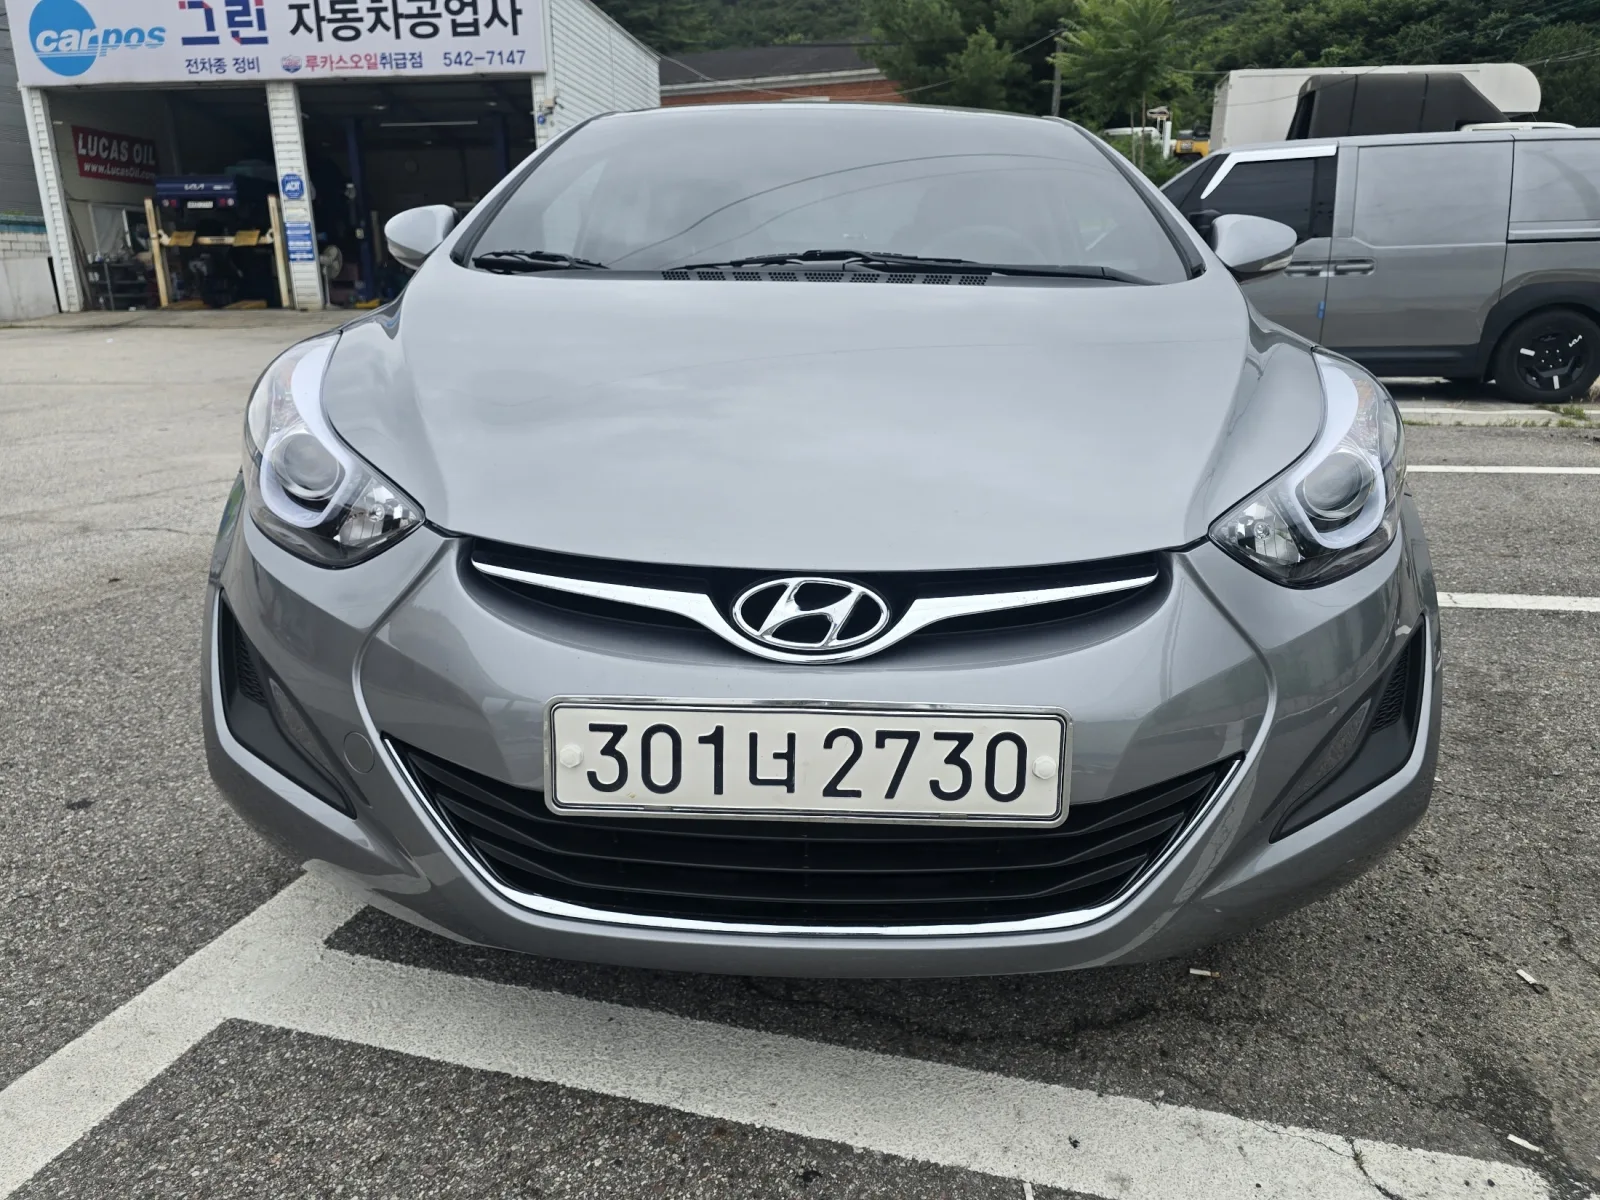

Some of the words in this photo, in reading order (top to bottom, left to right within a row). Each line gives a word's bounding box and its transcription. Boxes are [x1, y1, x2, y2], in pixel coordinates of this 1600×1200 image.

[178, 0, 269, 45] 그린
[288, 0, 523, 42] 자동차공업사
[35, 26, 166, 56] carpos
[185, 57, 228, 75] 전차종
[232, 56, 261, 74] 정비
[305, 51, 424, 71] 루카스오일취급점
[443, 50, 526, 67] 542-7147
[78, 133, 129, 162] LUCAS
[133, 143, 156, 166] OIL
